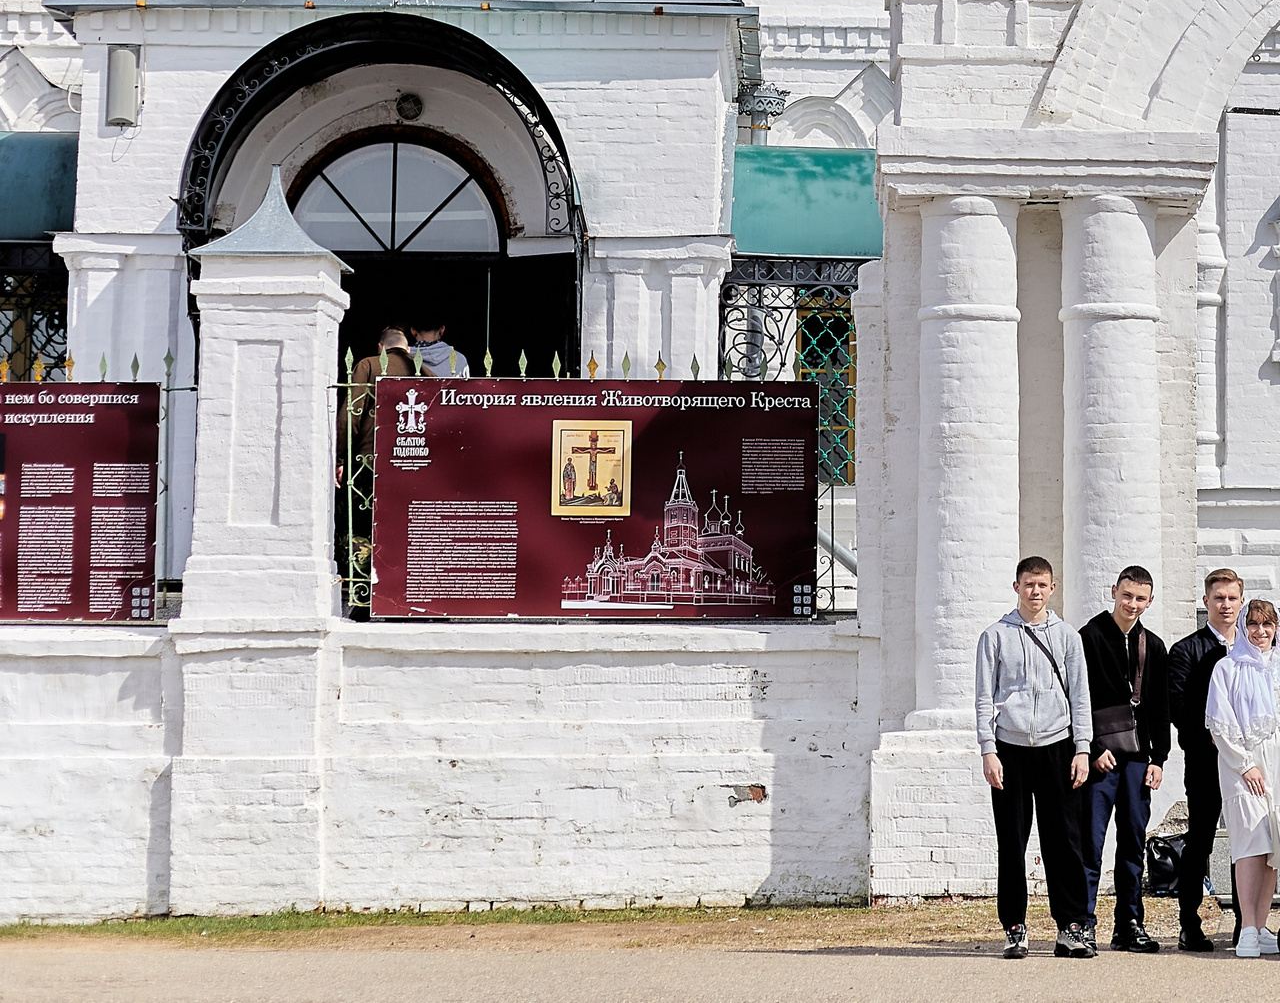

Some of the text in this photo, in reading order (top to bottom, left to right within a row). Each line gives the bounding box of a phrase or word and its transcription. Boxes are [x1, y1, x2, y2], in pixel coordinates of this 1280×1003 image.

[4, 390, 139, 407] нем бо совершися
[440, 388, 812, 411] История явления Животворящего Креста
[4, 413, 95, 427] искупления
